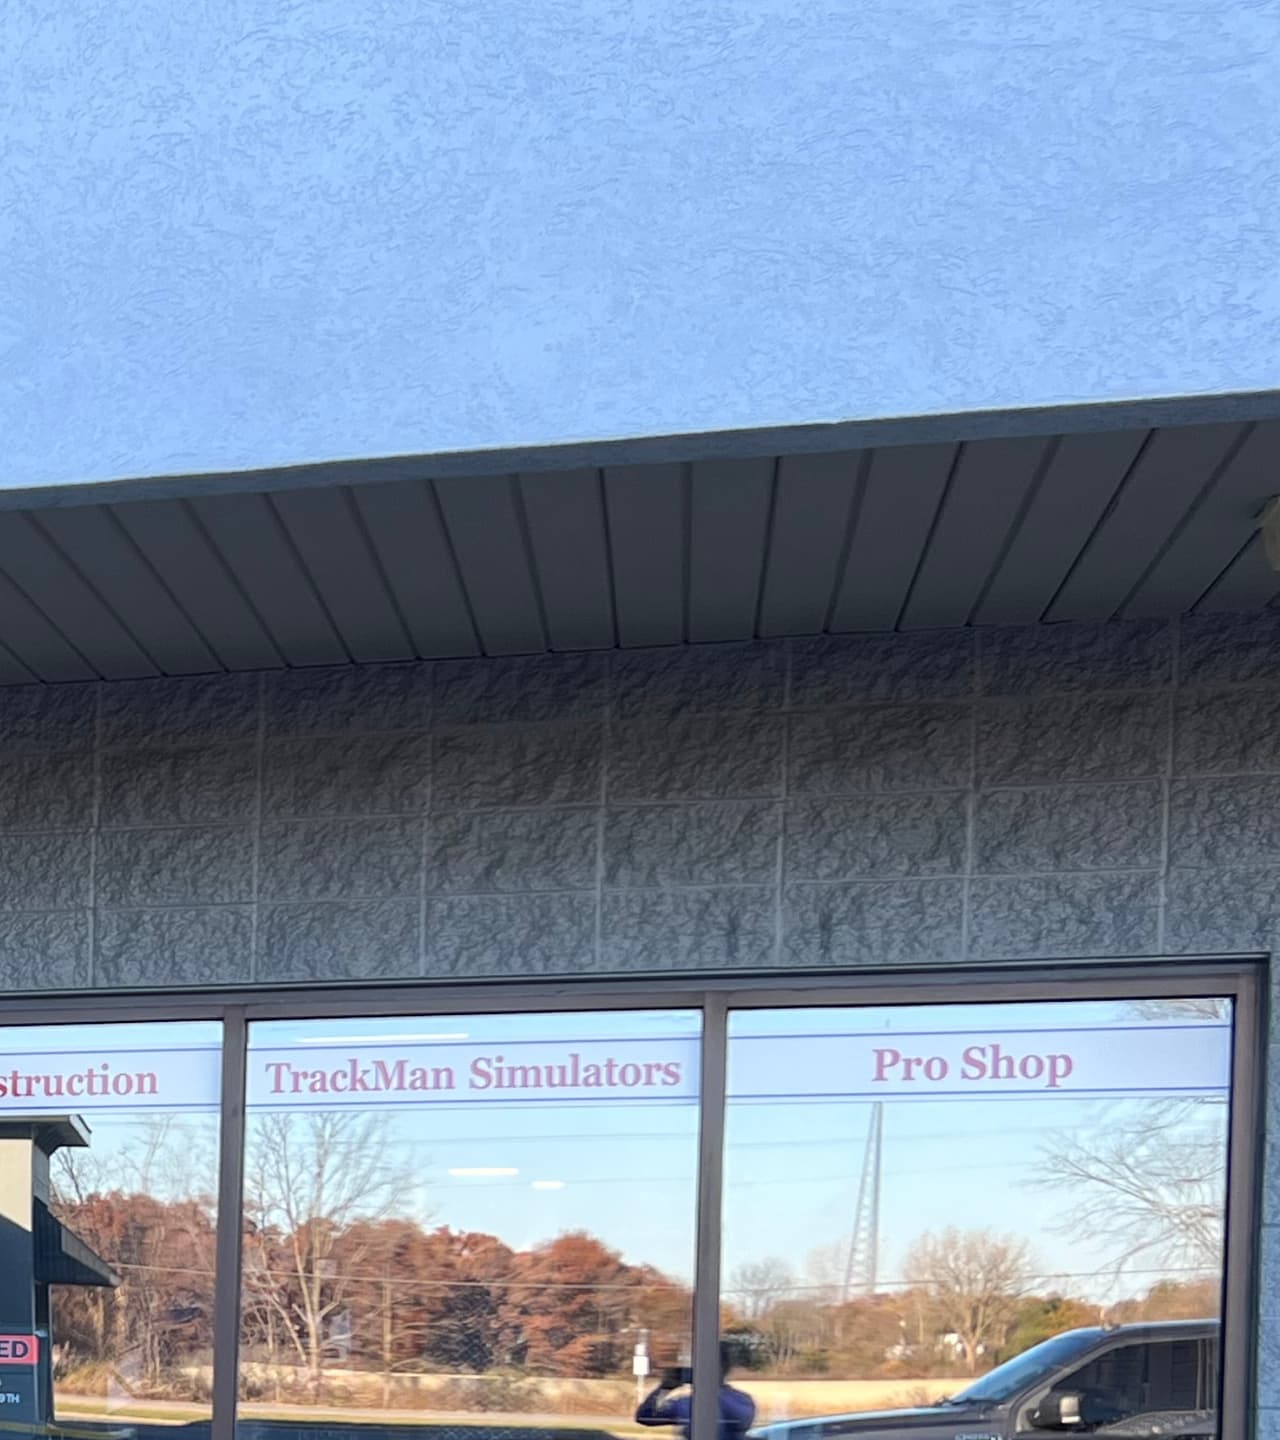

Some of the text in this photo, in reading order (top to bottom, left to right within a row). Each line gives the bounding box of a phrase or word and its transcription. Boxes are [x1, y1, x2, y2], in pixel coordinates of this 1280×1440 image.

[265, 1053, 681, 1093] TrackMan Simulators
[872, 1044, 1073, 1088] Pro Shop
